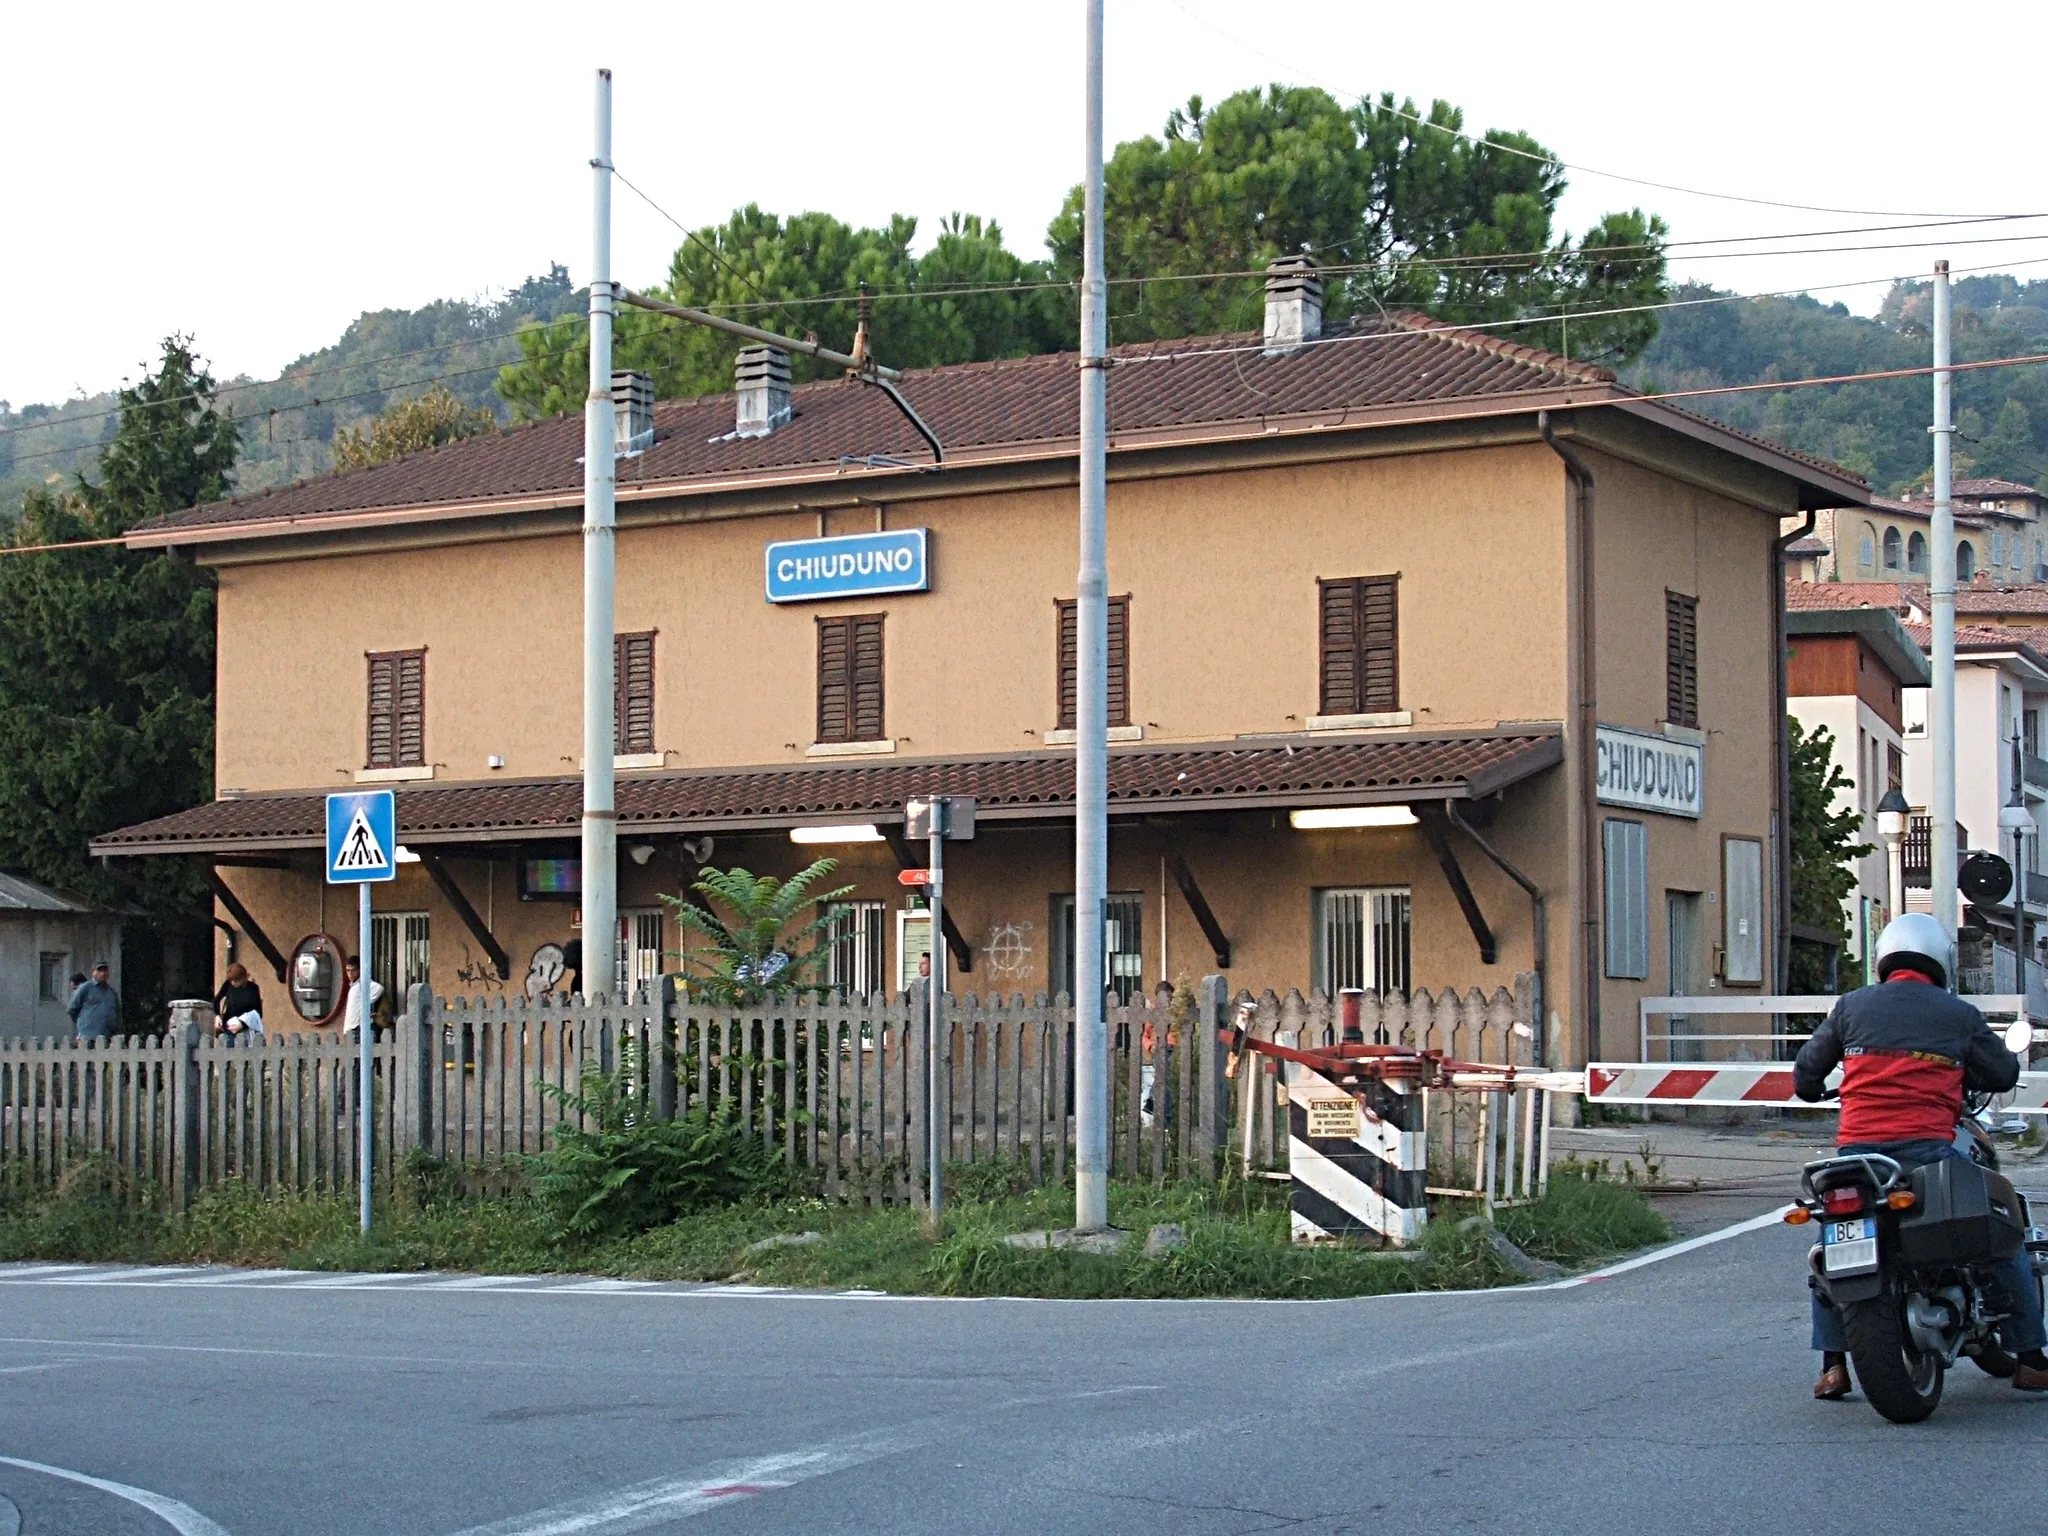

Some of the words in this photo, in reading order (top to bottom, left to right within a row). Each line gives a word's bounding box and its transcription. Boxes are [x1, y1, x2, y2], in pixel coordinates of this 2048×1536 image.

[777, 548, 913, 582] CHIUDUNO
[1597, 738, 1696, 803] CHIUDUNO
[1837, 1222, 1855, 1241] BC
